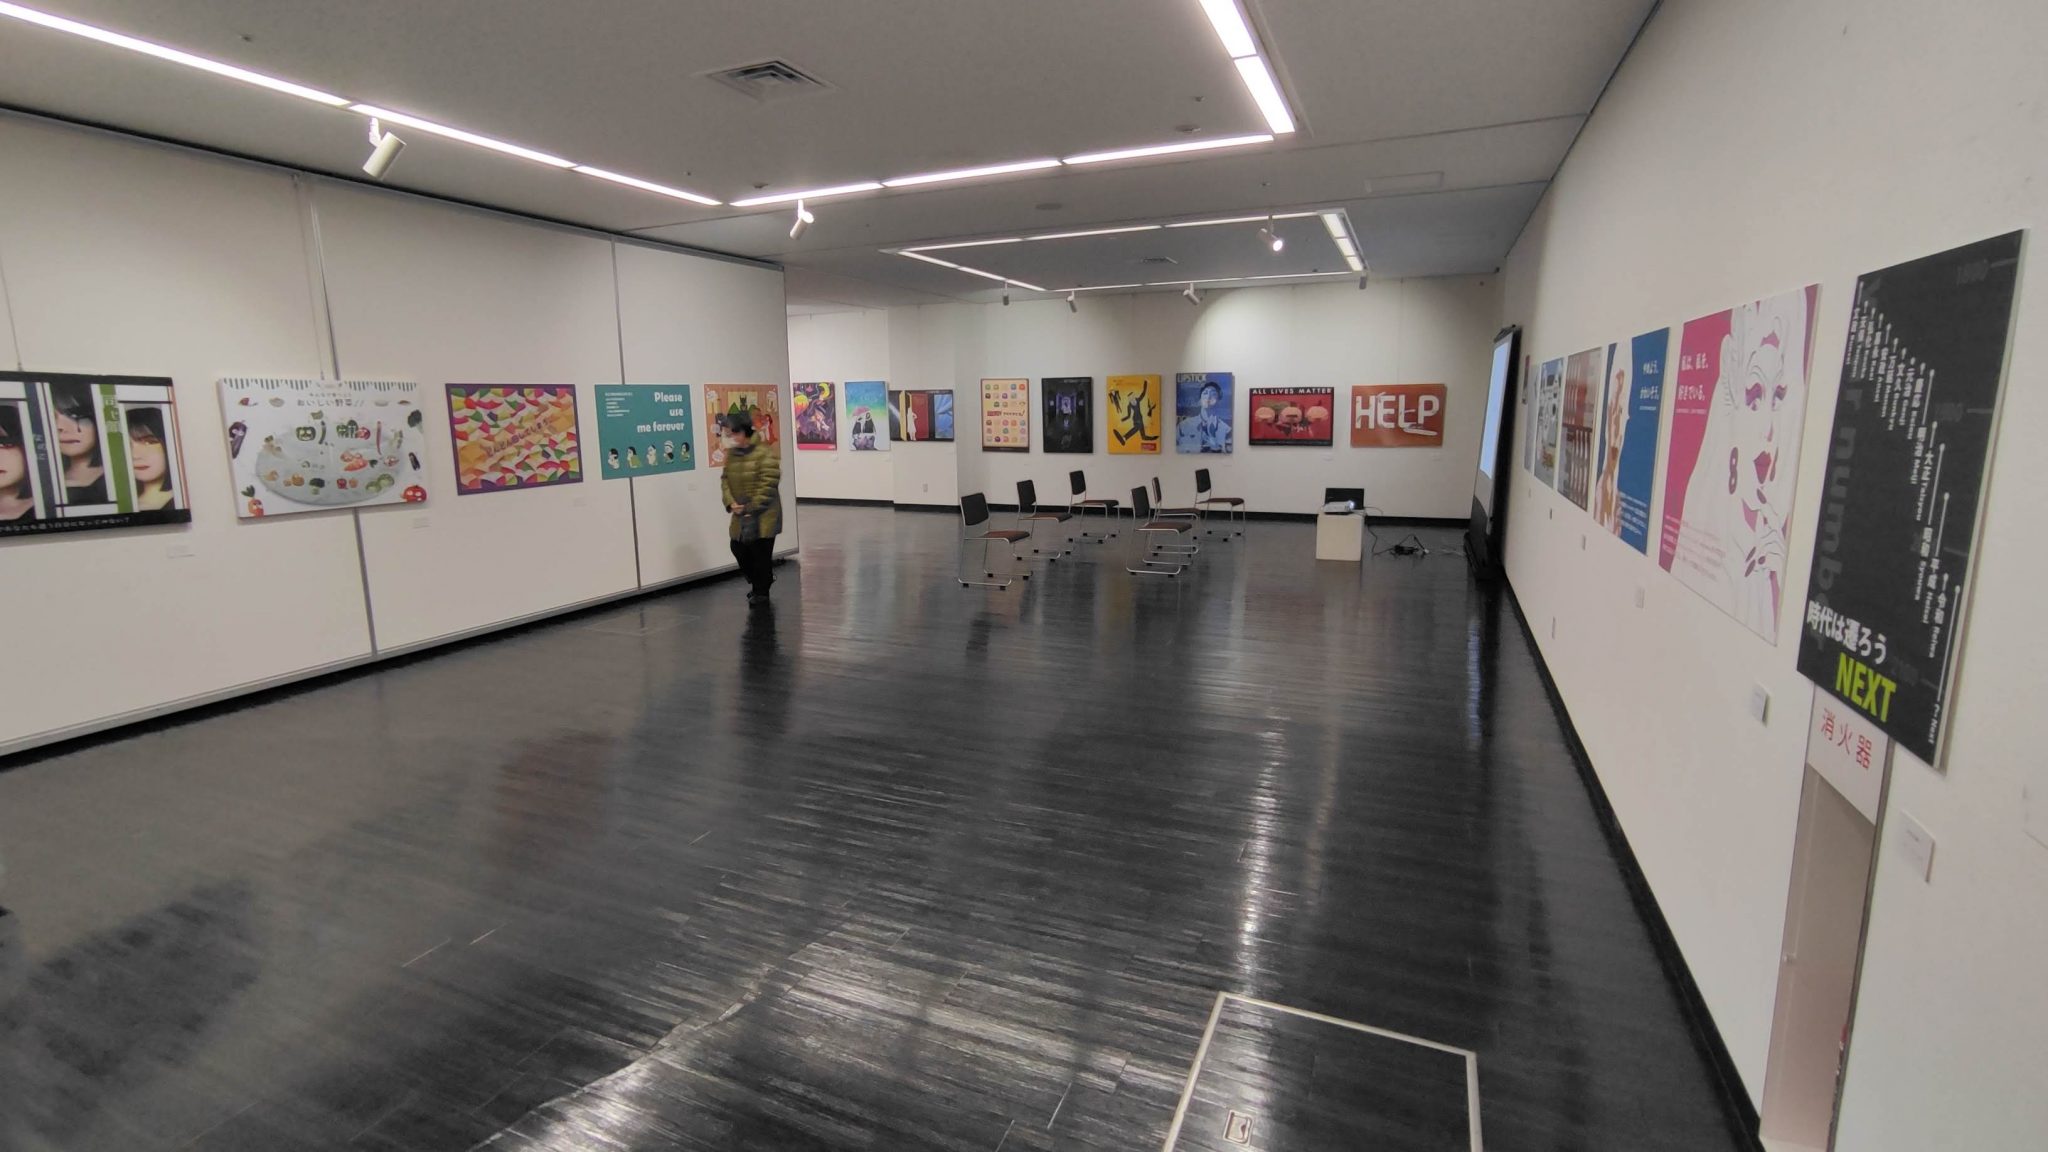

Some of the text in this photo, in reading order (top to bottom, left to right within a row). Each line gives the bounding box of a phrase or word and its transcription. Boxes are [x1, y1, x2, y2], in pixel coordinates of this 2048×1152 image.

[654, 391, 683, 402] Please
[669, 408, 684, 416] use
[1355, 392, 1440, 433] HELP
[637, 421, 685, 432] me forever
[1835, 651, 1897, 723] NEXT
[1821, 707, 1872, 770] 消火器
